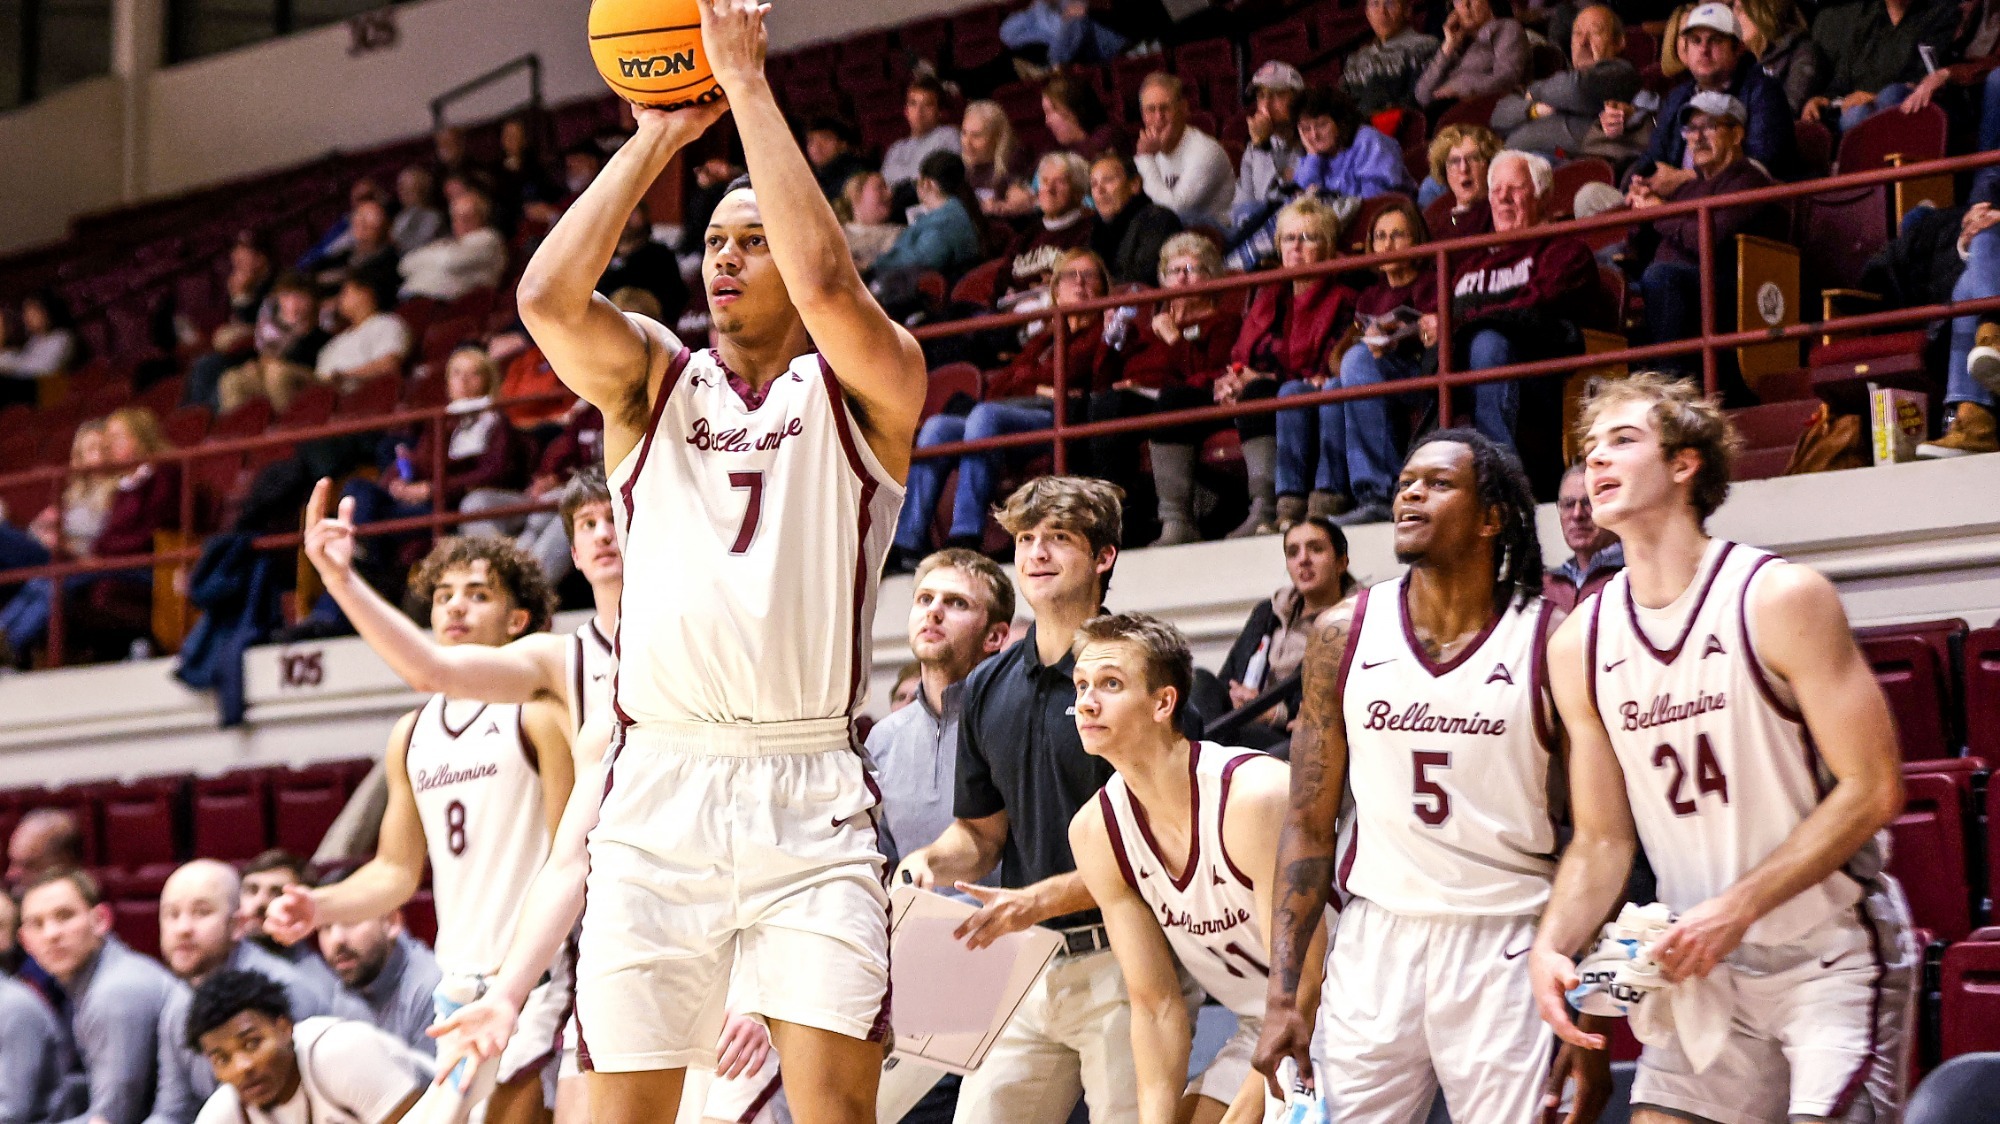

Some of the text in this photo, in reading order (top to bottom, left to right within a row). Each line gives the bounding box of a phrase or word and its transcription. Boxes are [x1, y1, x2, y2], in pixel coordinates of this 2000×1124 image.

[618, 48, 695, 78] NCAA
[727, 470, 767, 556] 7
[281, 651, 323, 687] 105
[1363, 700, 1507, 736] Bellarmine
[417, 762, 498, 793] Bellarmine
[1411, 749, 1452, 829] 5
[1651, 732, 1729, 818] 24
[445, 799, 467, 858] 8
